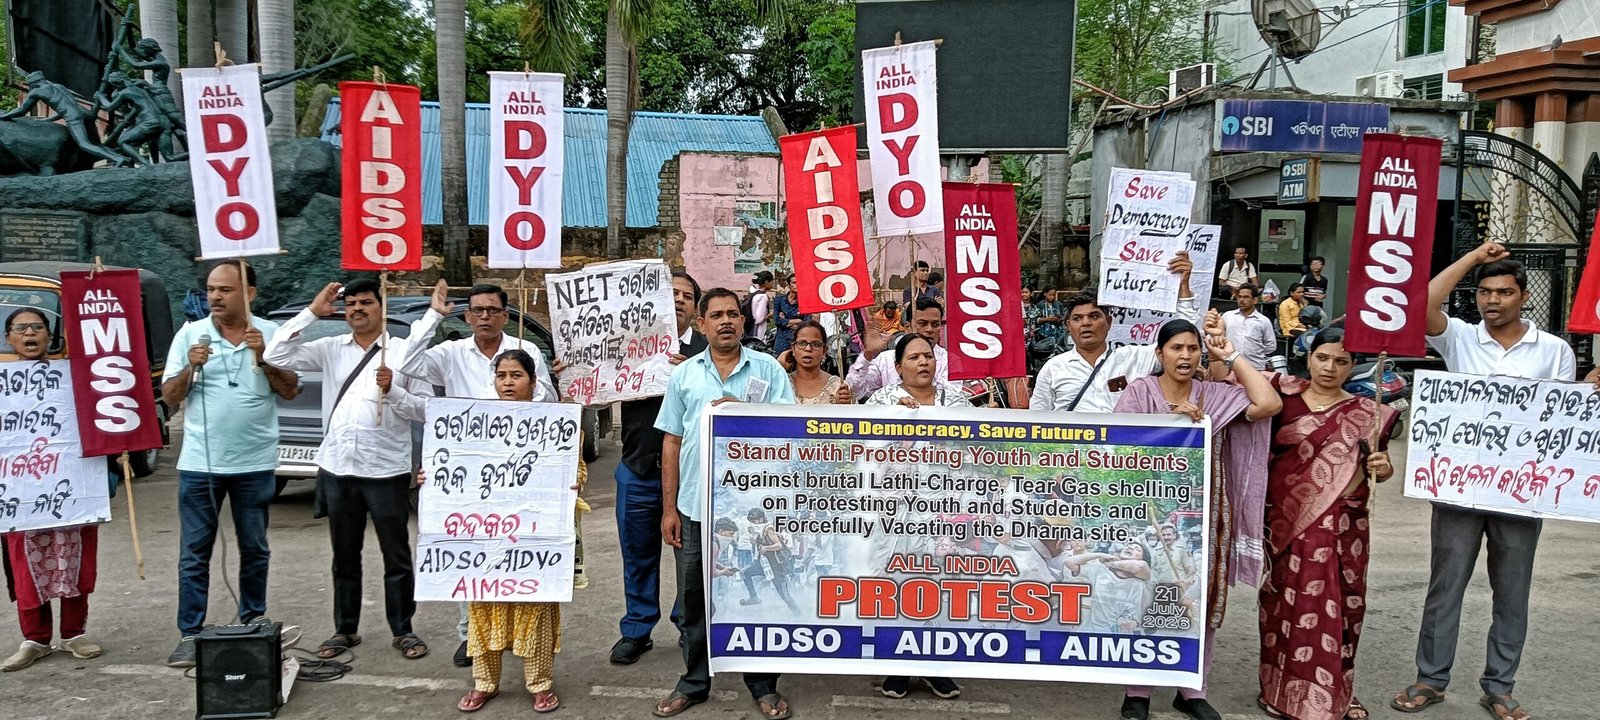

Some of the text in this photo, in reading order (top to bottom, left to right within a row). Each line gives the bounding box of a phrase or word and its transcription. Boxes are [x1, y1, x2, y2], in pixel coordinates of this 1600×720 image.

[879, 63, 911, 78] ALL
[202, 85, 237, 97] ALL
[876, 75, 917, 90] INDIA
[199, 97, 244, 109] INDIA
[508, 92, 541, 103] ALL
[504, 105, 546, 115] INDIA
[1241, 116, 1273, 136] SBI
[1330, 123, 1360, 138] एटीएम
[1365, 126, 1387, 134] ATM
[877, 92, 926, 218] DYO
[1380, 156, 1415, 172] ALL
[200, 114, 260, 240] DYO
[360, 89, 408, 264] AIDSO
[1290, 162, 1306, 176] SBI
[504, 120, 547, 250] DYO
[1124, 177, 1169, 200] Save
[1283, 182, 1304, 197] ATM
[1373, 172, 1418, 189] INDIA
[802, 135, 859, 305] AIDSO
[960, 203, 991, 217] ALL
[1110, 203, 1190, 236] Democracy
[955, 217, 996, 231] INDIA
[1119, 241, 1164, 263] Save
[1359, 191, 1418, 331] MSS
[1105, 268, 1158, 292] Future
[83, 289, 118, 301] ALL
[554, 272, 613, 310] NEET
[955, 235, 1003, 359] MSS
[78, 302, 124, 315] INDIA
[80, 317, 141, 433] MSS
[806, 420, 853, 435] Save
[859, 421, 974, 439] Democracy,
[979, 424, 1026, 439] Save
[1031, 425, 1095, 440] Future
[727, 442, 1188, 471] Stand with Protesting Youth and Students
[722, 470, 1190, 501] Against brutal Lathi-Charge, Tear Gas shelling
[762, 494, 1147, 520] on Protesting Youth and Students and
[775, 516, 1133, 542] Forcefully Vacating the Dharna site.
[495, 549, 562, 573] AIDYO
[889, 555, 1018, 575] ALL INDIA
[452, 576, 540, 600] AIMSS
[1155, 586, 1178, 601] 21
[818, 577, 1091, 624] PROTEST
[1147, 602, 1186, 617] July
[1143, 616, 1191, 630] 2026
[726, 627, 1181, 664] AIDSO AIDYO AIMSS
